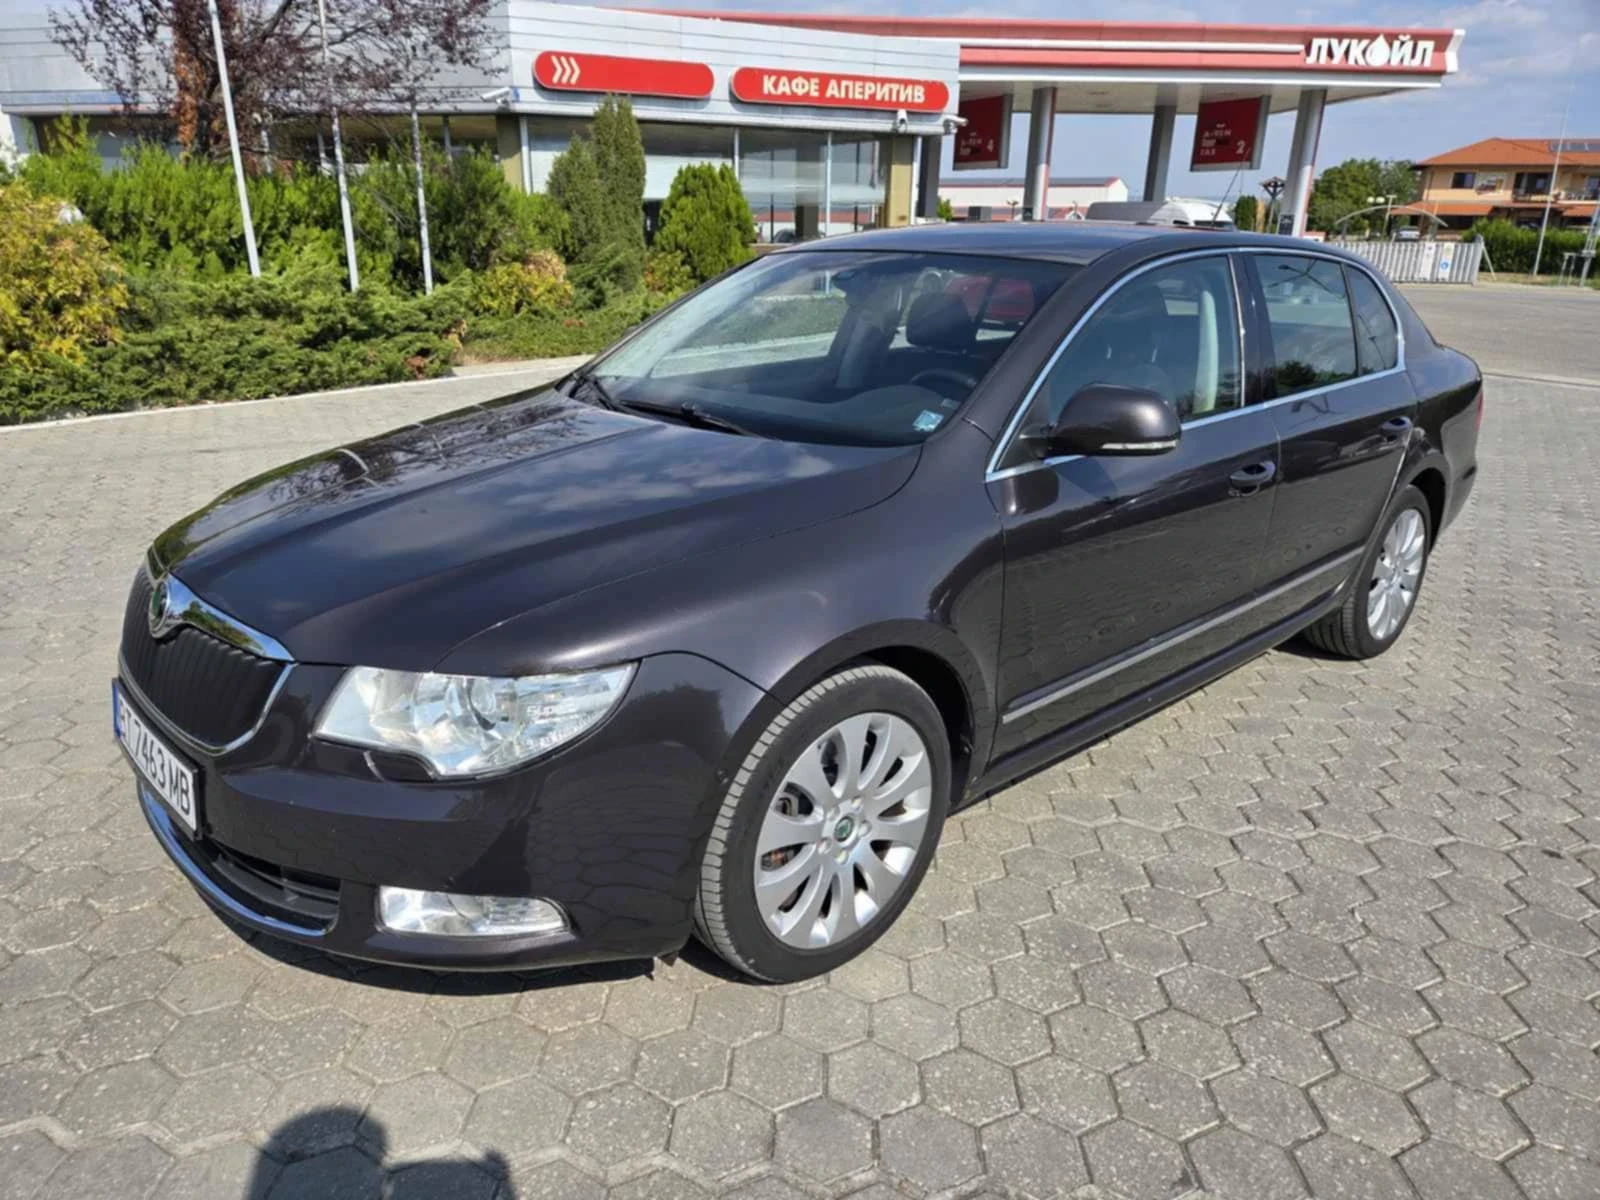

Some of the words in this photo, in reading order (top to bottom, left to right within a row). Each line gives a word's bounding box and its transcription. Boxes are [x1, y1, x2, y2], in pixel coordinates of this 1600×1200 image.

[1305, 34, 1435, 67] ЛУКОЙЛ
[763, 75, 820, 97] КАФЕ
[825, 79, 926, 103] АПЕРИТИВ
[1235, 139, 1246, 155] 2
[134, 720, 166, 789] 7463
[168, 759, 191, 816] MB
